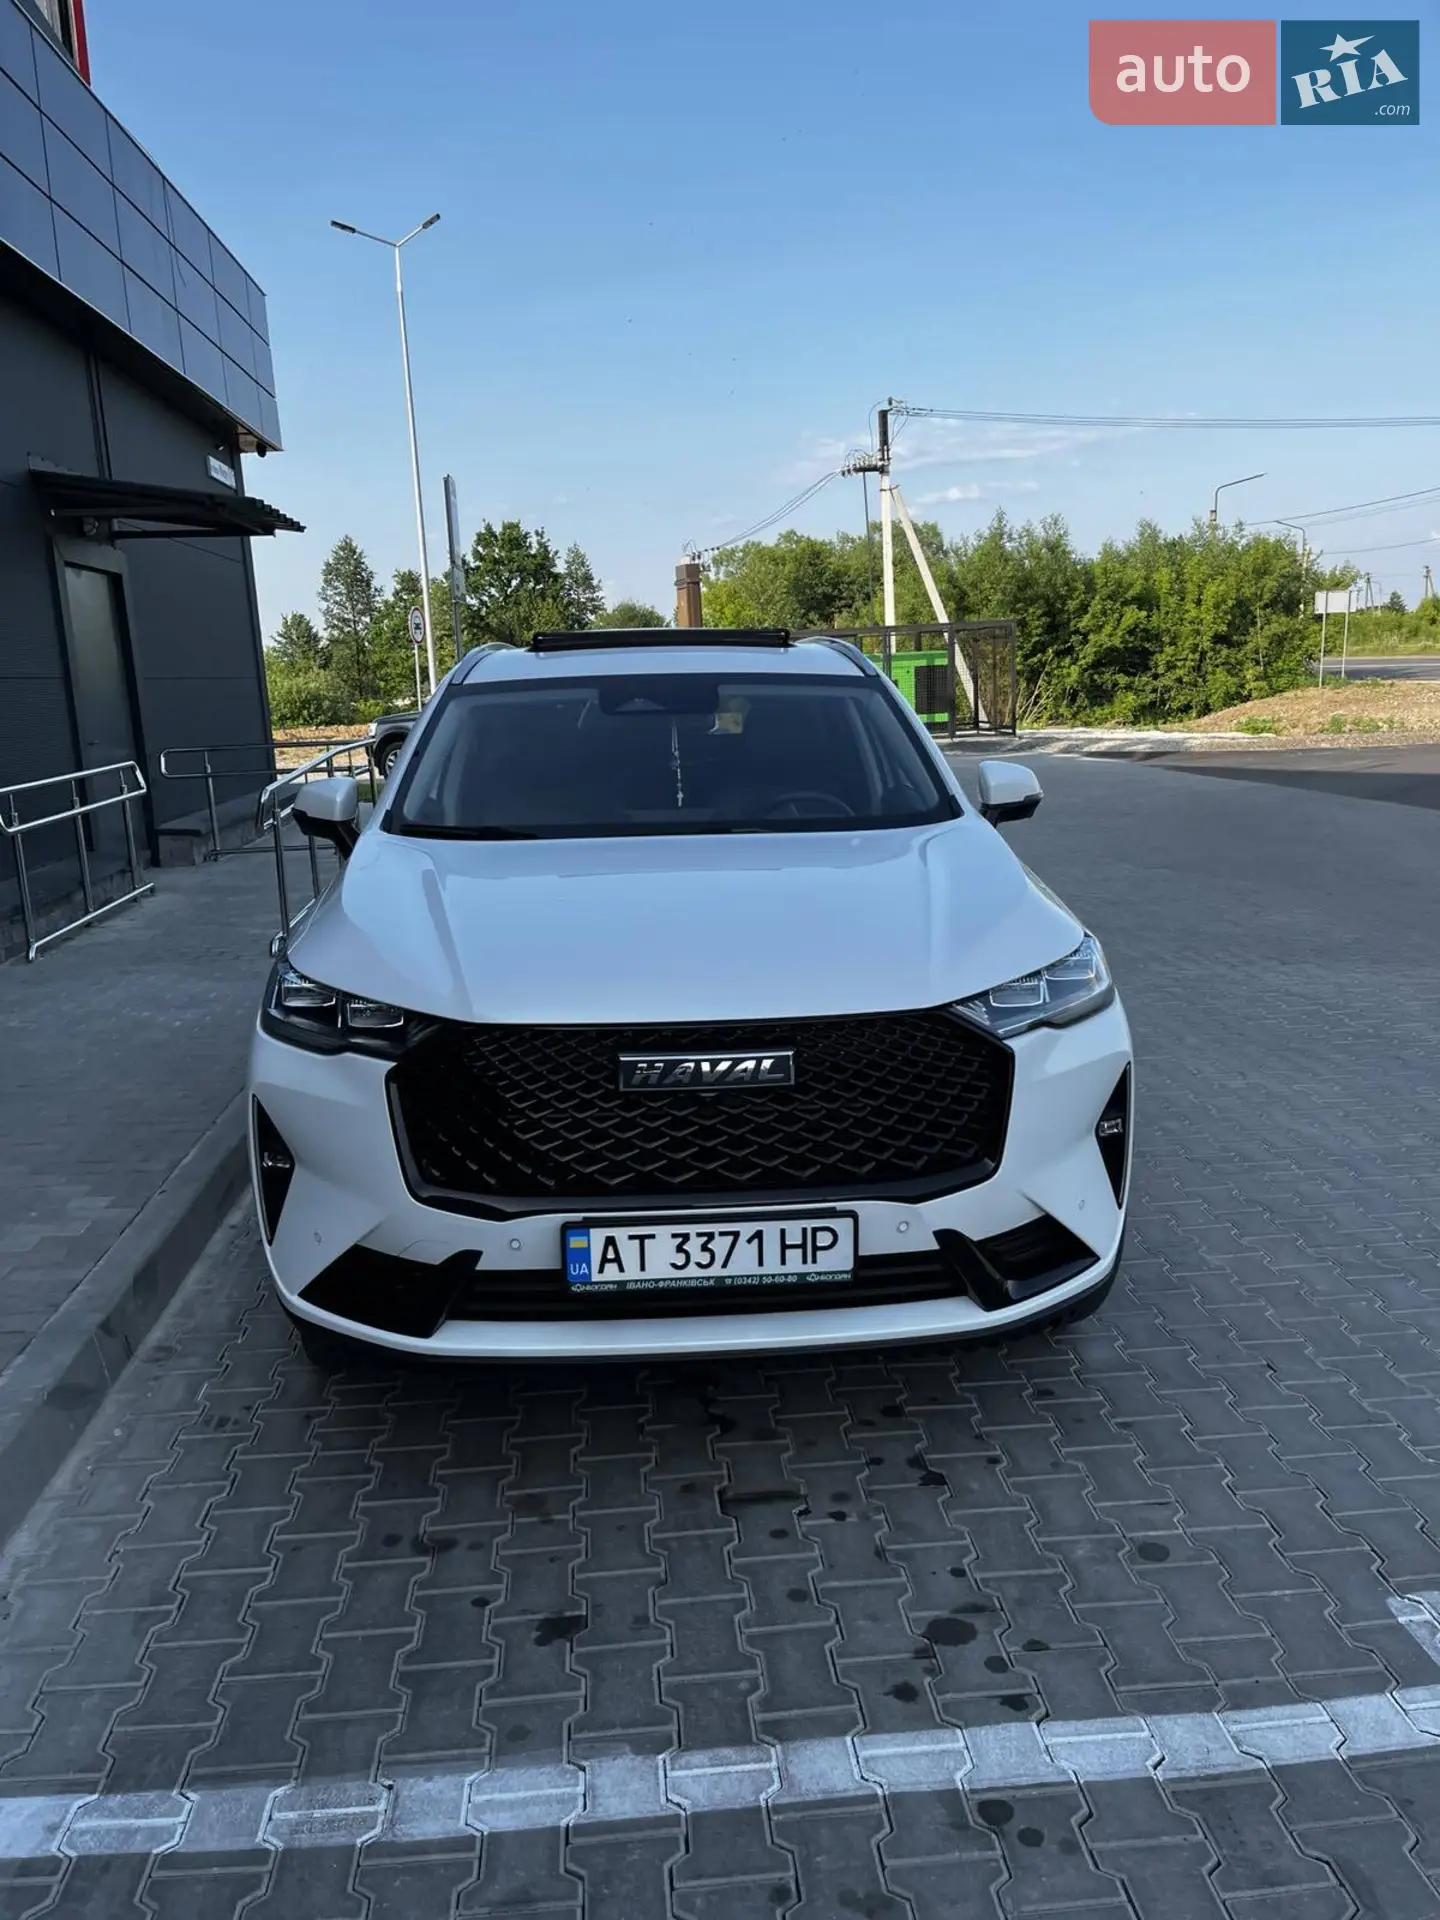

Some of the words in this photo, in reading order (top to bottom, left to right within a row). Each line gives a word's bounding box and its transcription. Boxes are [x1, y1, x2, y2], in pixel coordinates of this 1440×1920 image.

[631, 1058, 784, 1085] HAVAL
[597, 1233, 656, 1274] AT
[669, 1229, 764, 1270] 3371
[780, 1226, 839, 1266] HP
[570, 1263, 589, 1275] UA
